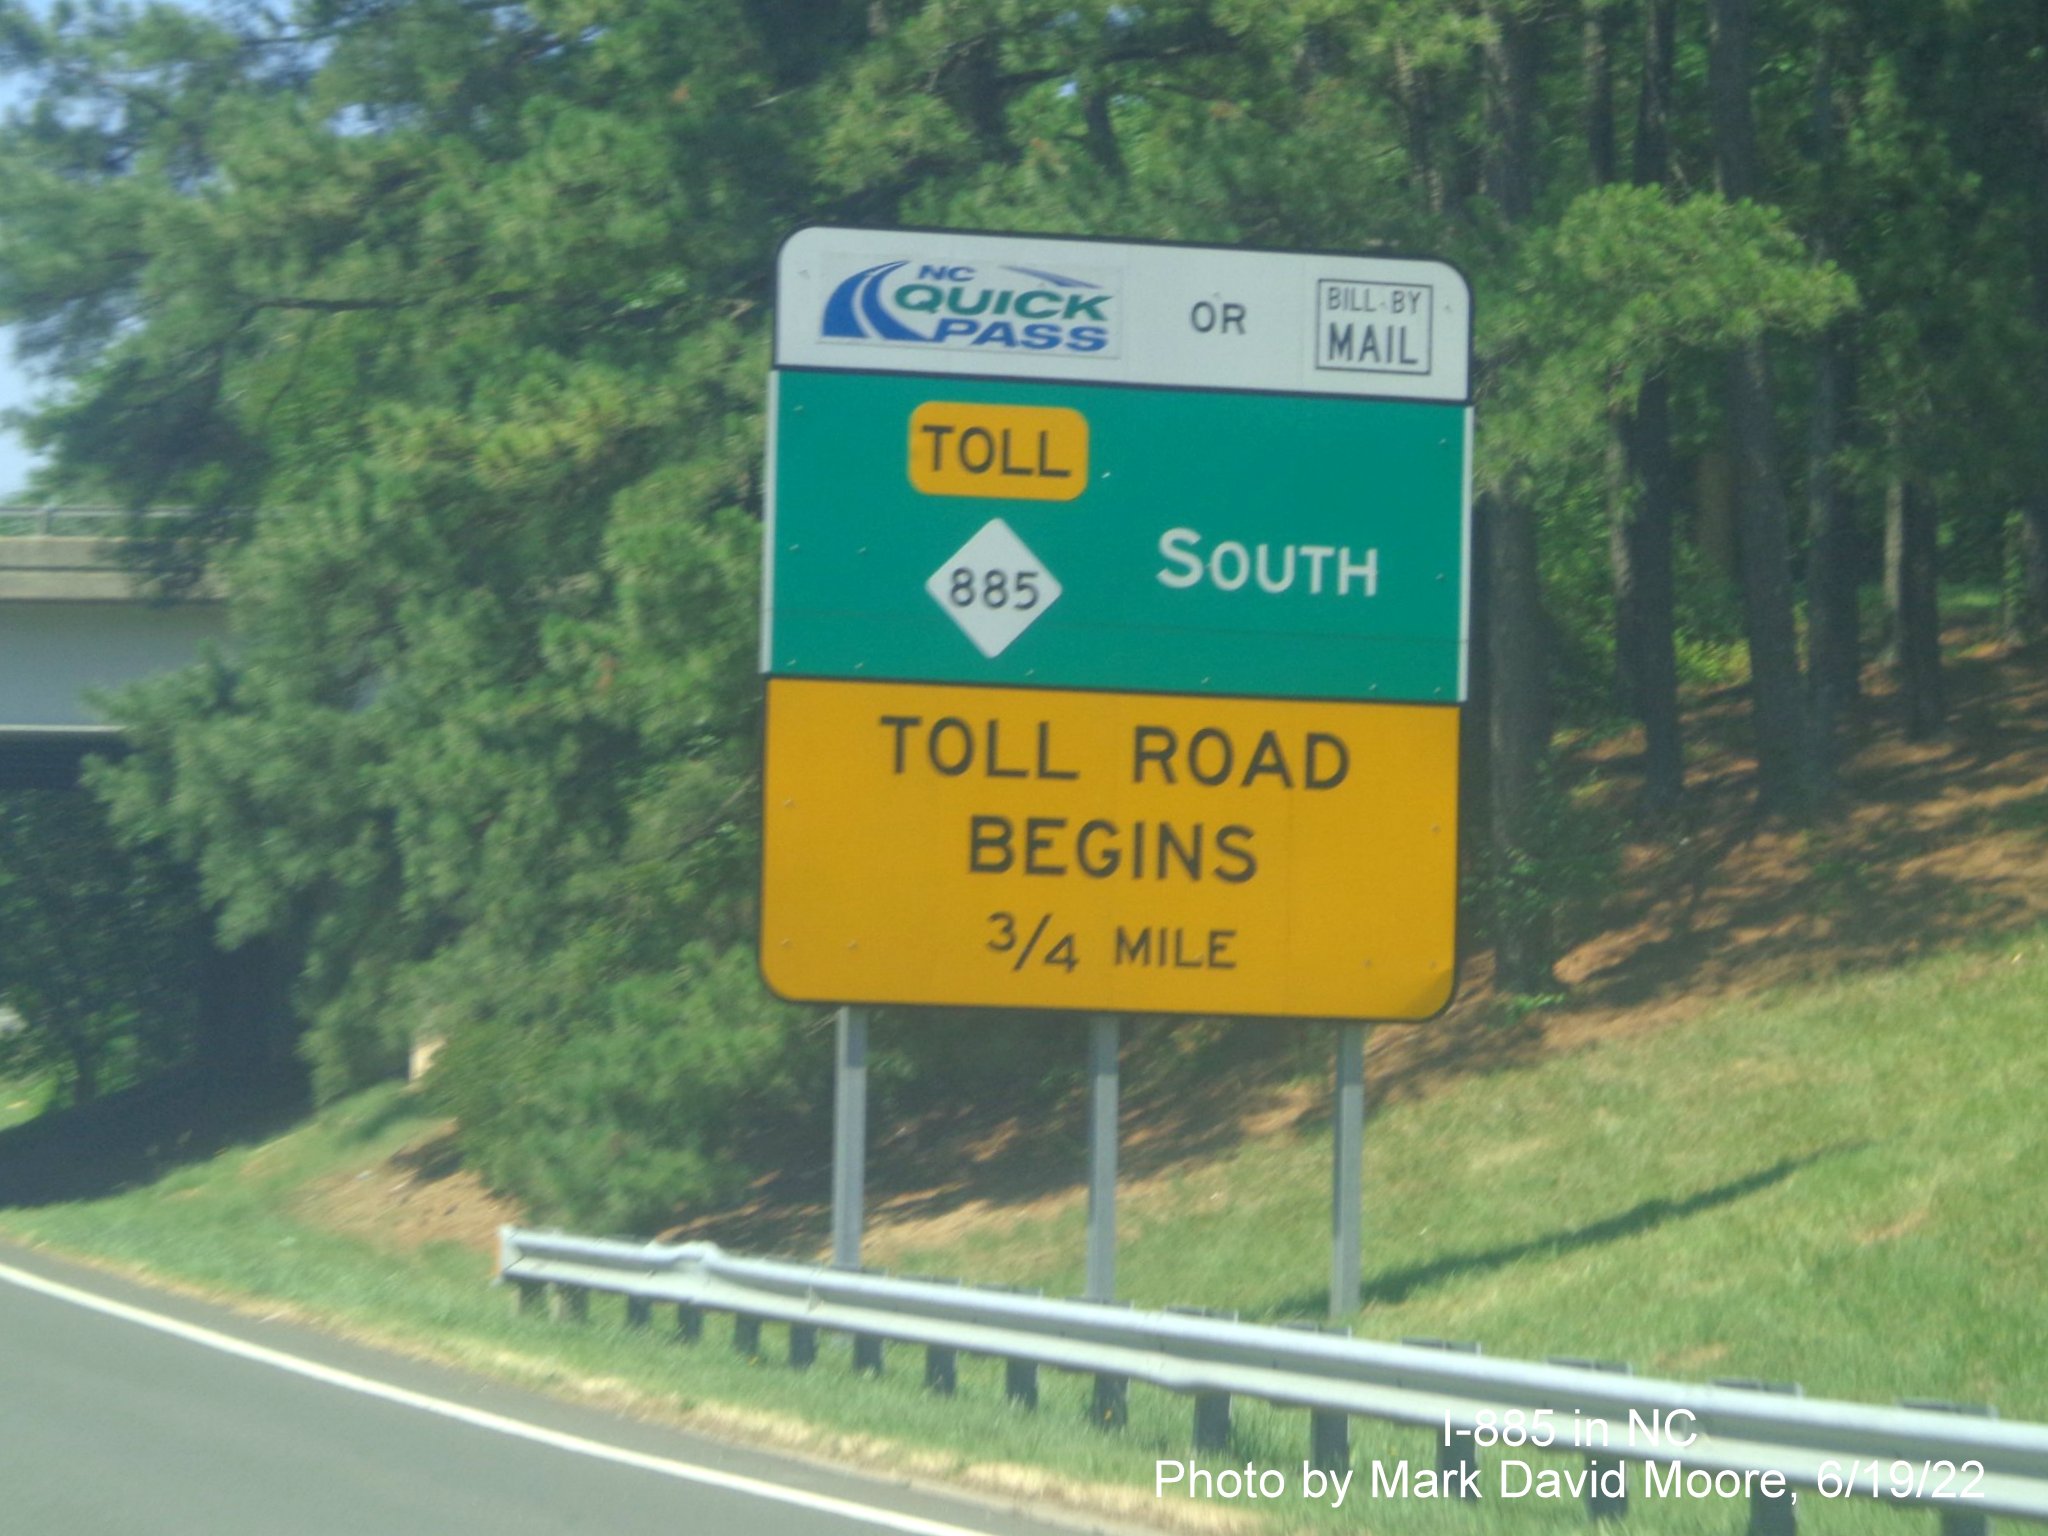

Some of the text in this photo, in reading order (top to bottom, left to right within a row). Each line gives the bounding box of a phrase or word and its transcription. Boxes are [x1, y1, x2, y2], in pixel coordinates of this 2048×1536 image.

[917, 265, 976, 282] NC
[893, 284, 1114, 322] QUICK
[1190, 301, 1247, 335] OR
[1327, 287, 1422, 314] BILL BY
[932, 318, 1109, 352] PASS
[1327, 322, 1419, 365] MAIL
[921, 424, 1072, 478] TOLL
[1156, 527, 1379, 597] SOUTH
[949, 567, 1040, 611] 885
[879, 715, 1351, 791] TOLL ROAD
[969, 814, 1258, 884] BEGINS
[986, 911, 1237, 974] 3/4 MILE
